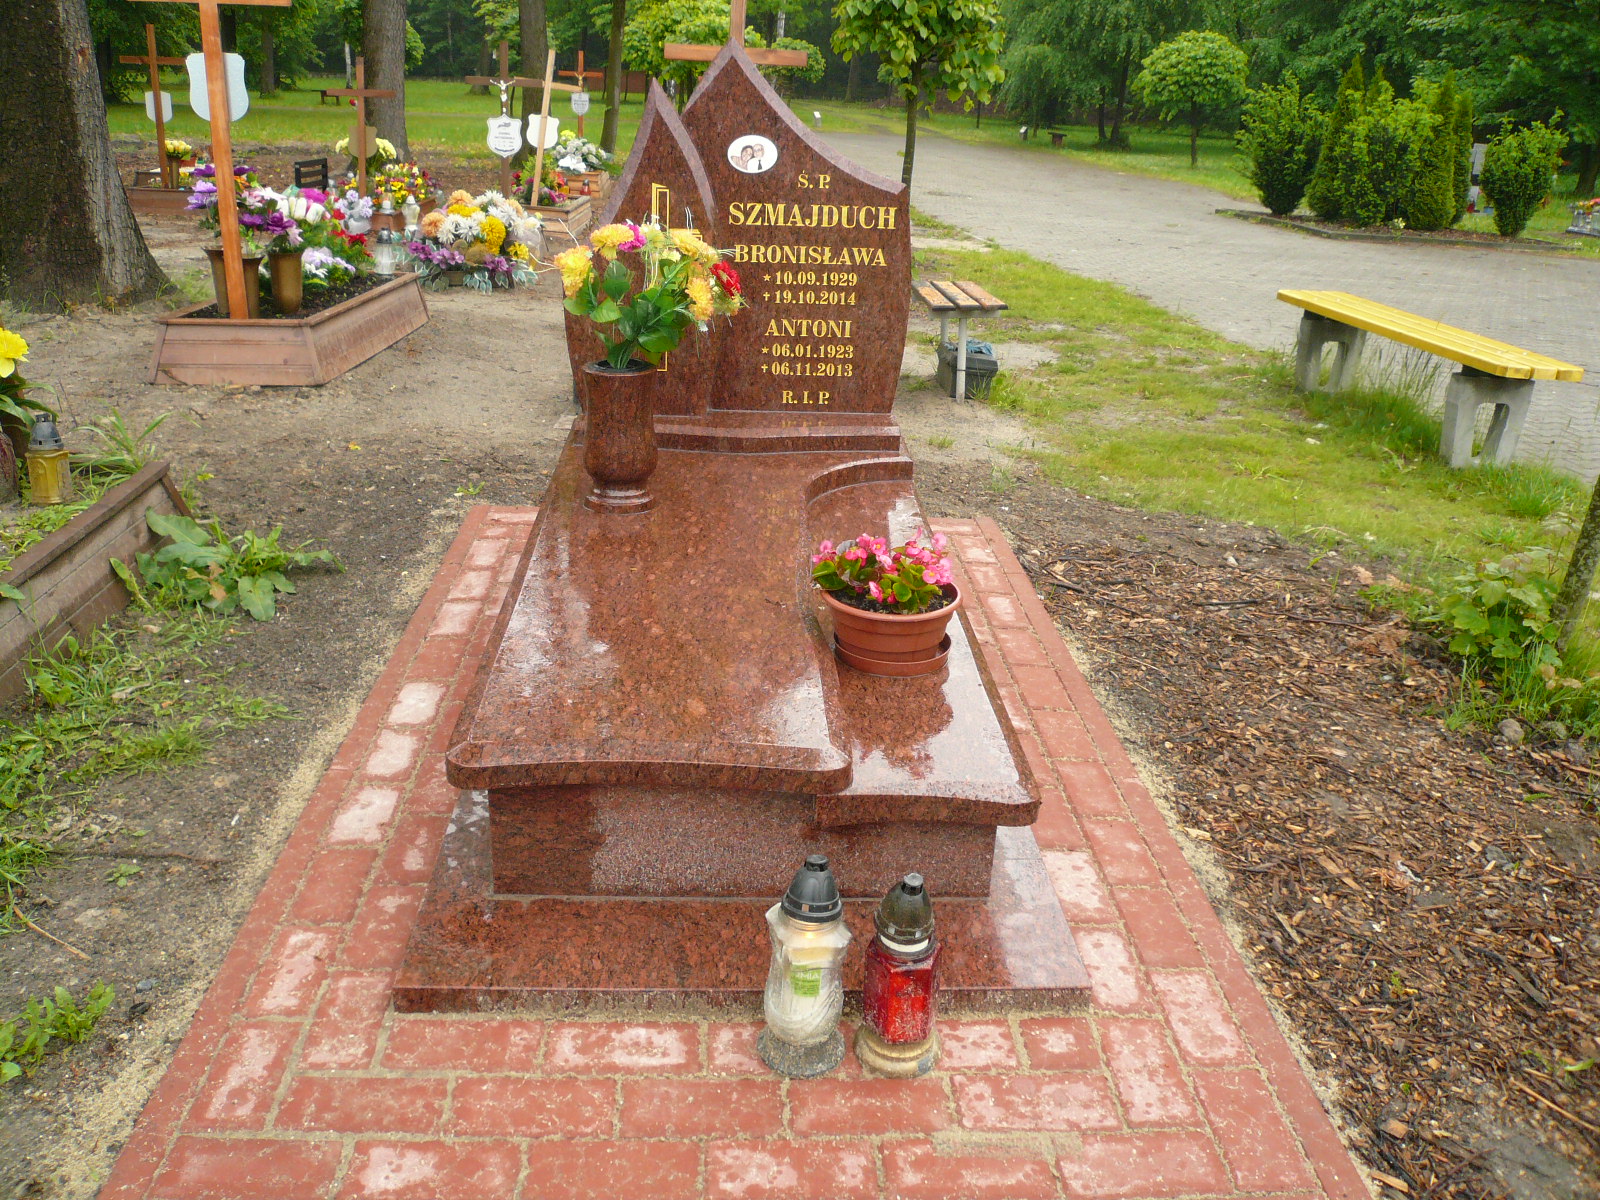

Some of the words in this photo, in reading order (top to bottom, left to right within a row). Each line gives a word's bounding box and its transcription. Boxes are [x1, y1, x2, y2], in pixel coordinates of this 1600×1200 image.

[728, 201, 898, 230] SZMAJDUCH
[734, 244, 888, 267] BRONISŁAWA
[774, 270, 858, 287] 10.09.1929
[774, 289, 857, 306] 19.10.2014
[764, 318, 853, 338] ANTONI
[771, 343, 854, 359] 06.01.1923
[771, 361, 853, 377] 06.11.2013
